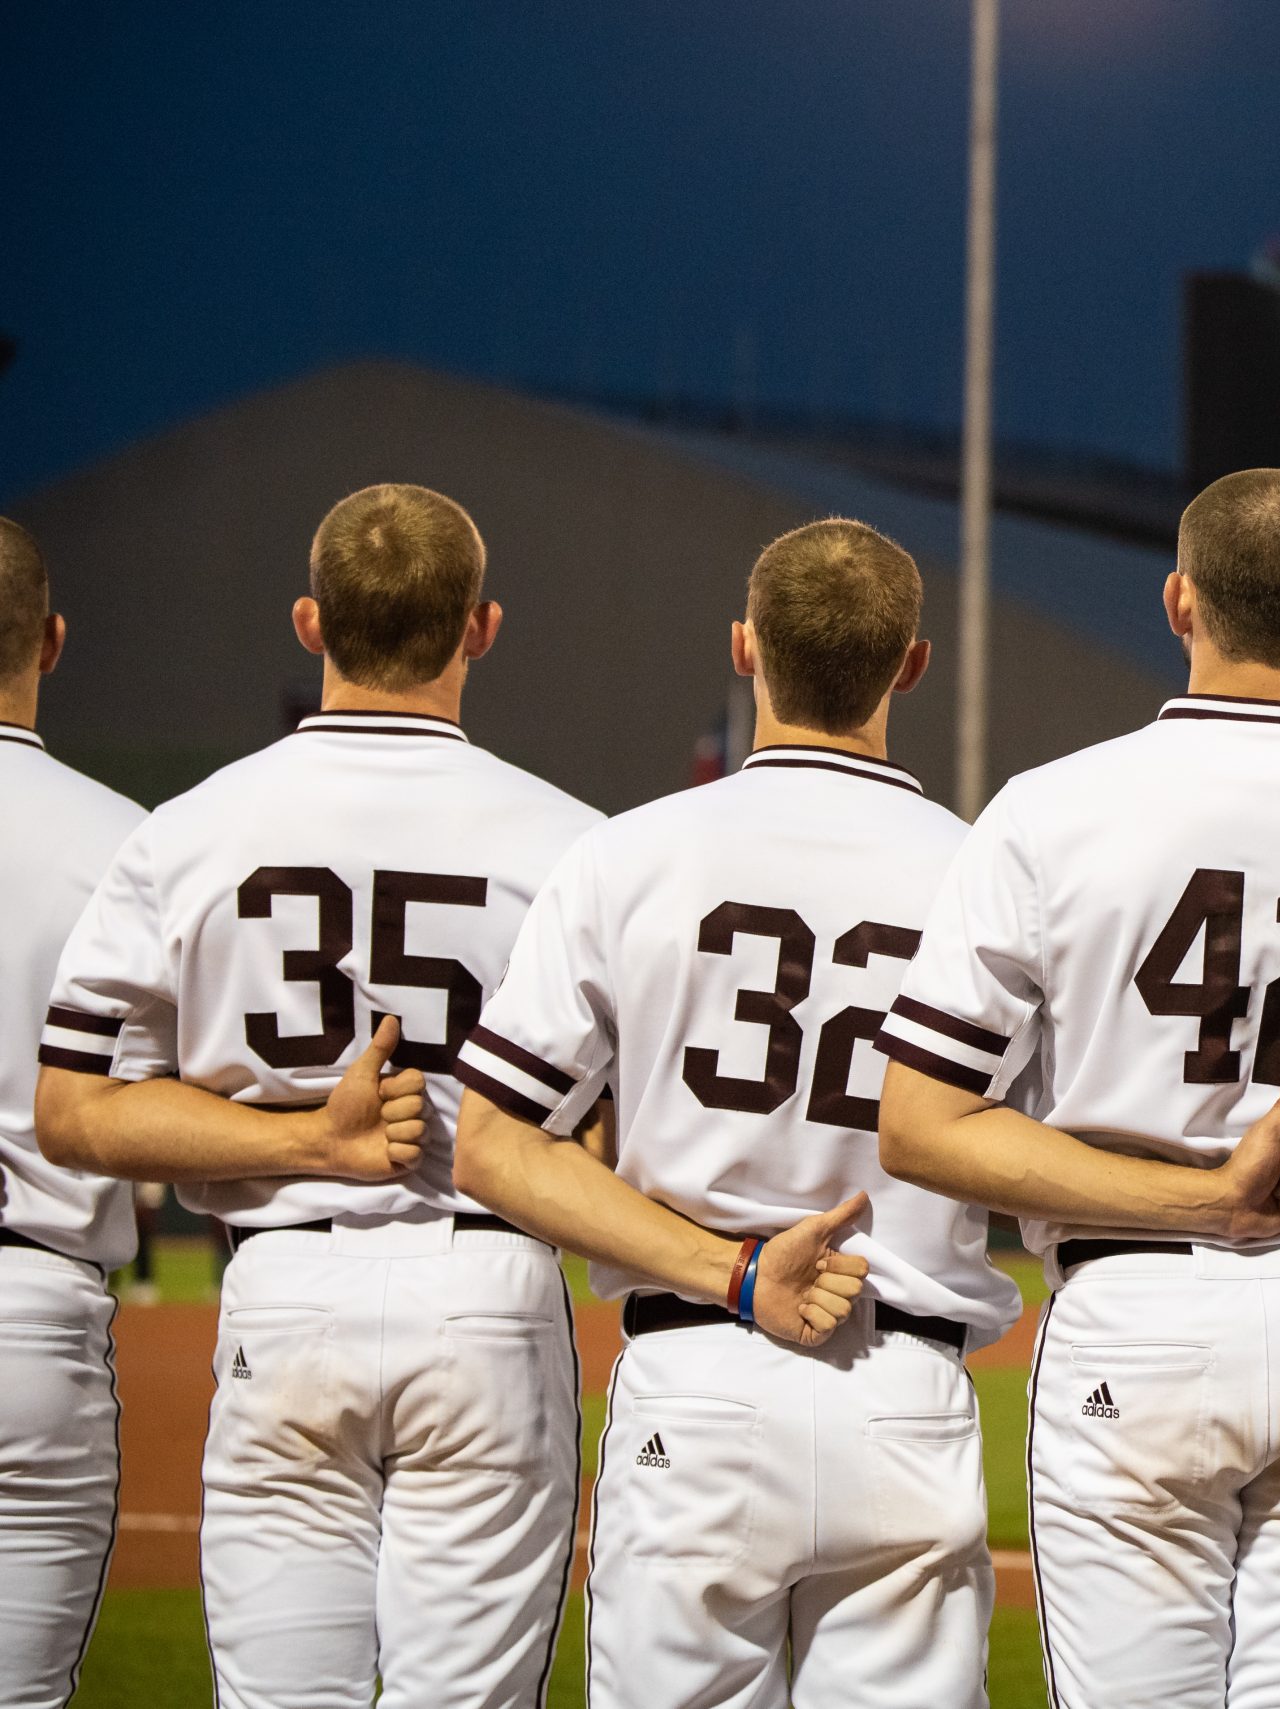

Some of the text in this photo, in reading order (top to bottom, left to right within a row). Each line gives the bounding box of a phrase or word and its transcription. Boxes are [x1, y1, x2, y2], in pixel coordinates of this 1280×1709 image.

[237, 866, 487, 1075] 35
[682, 900, 923, 1133] 32
[636, 1454, 671, 1469] adidas
[1081, 1403, 1120, 1419] adidas
